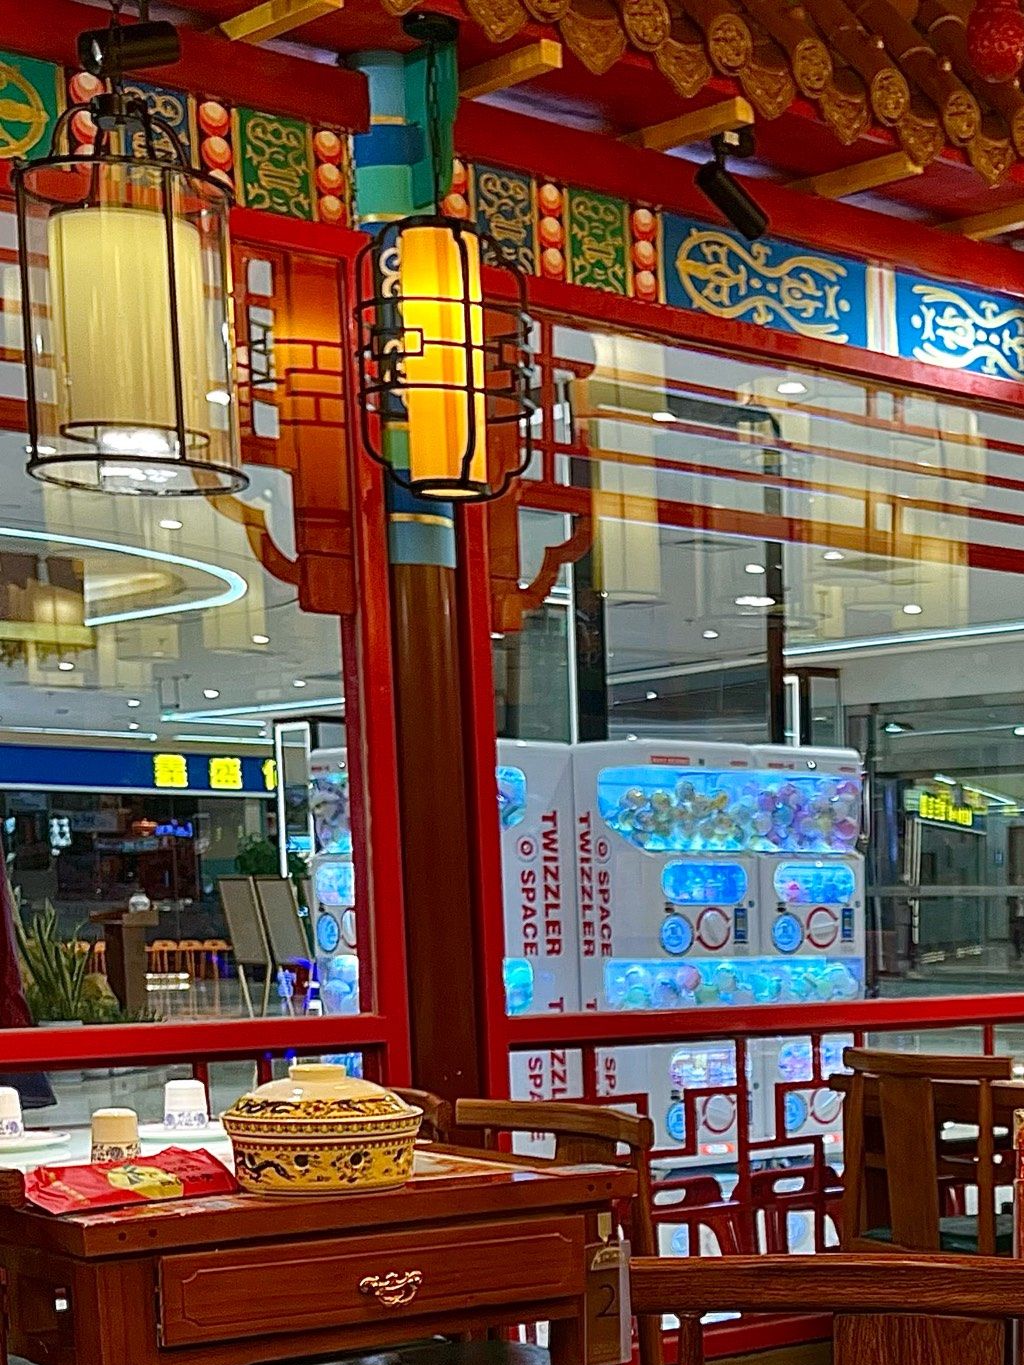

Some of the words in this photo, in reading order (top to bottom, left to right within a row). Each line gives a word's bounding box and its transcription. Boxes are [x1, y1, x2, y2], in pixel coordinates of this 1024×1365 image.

[520, 869, 538, 957] SPACE
[541, 811, 562, 957] TWIZZLER
[578, 811, 595, 957] TWIZZLER
[598, 870, 613, 957] SPACE
